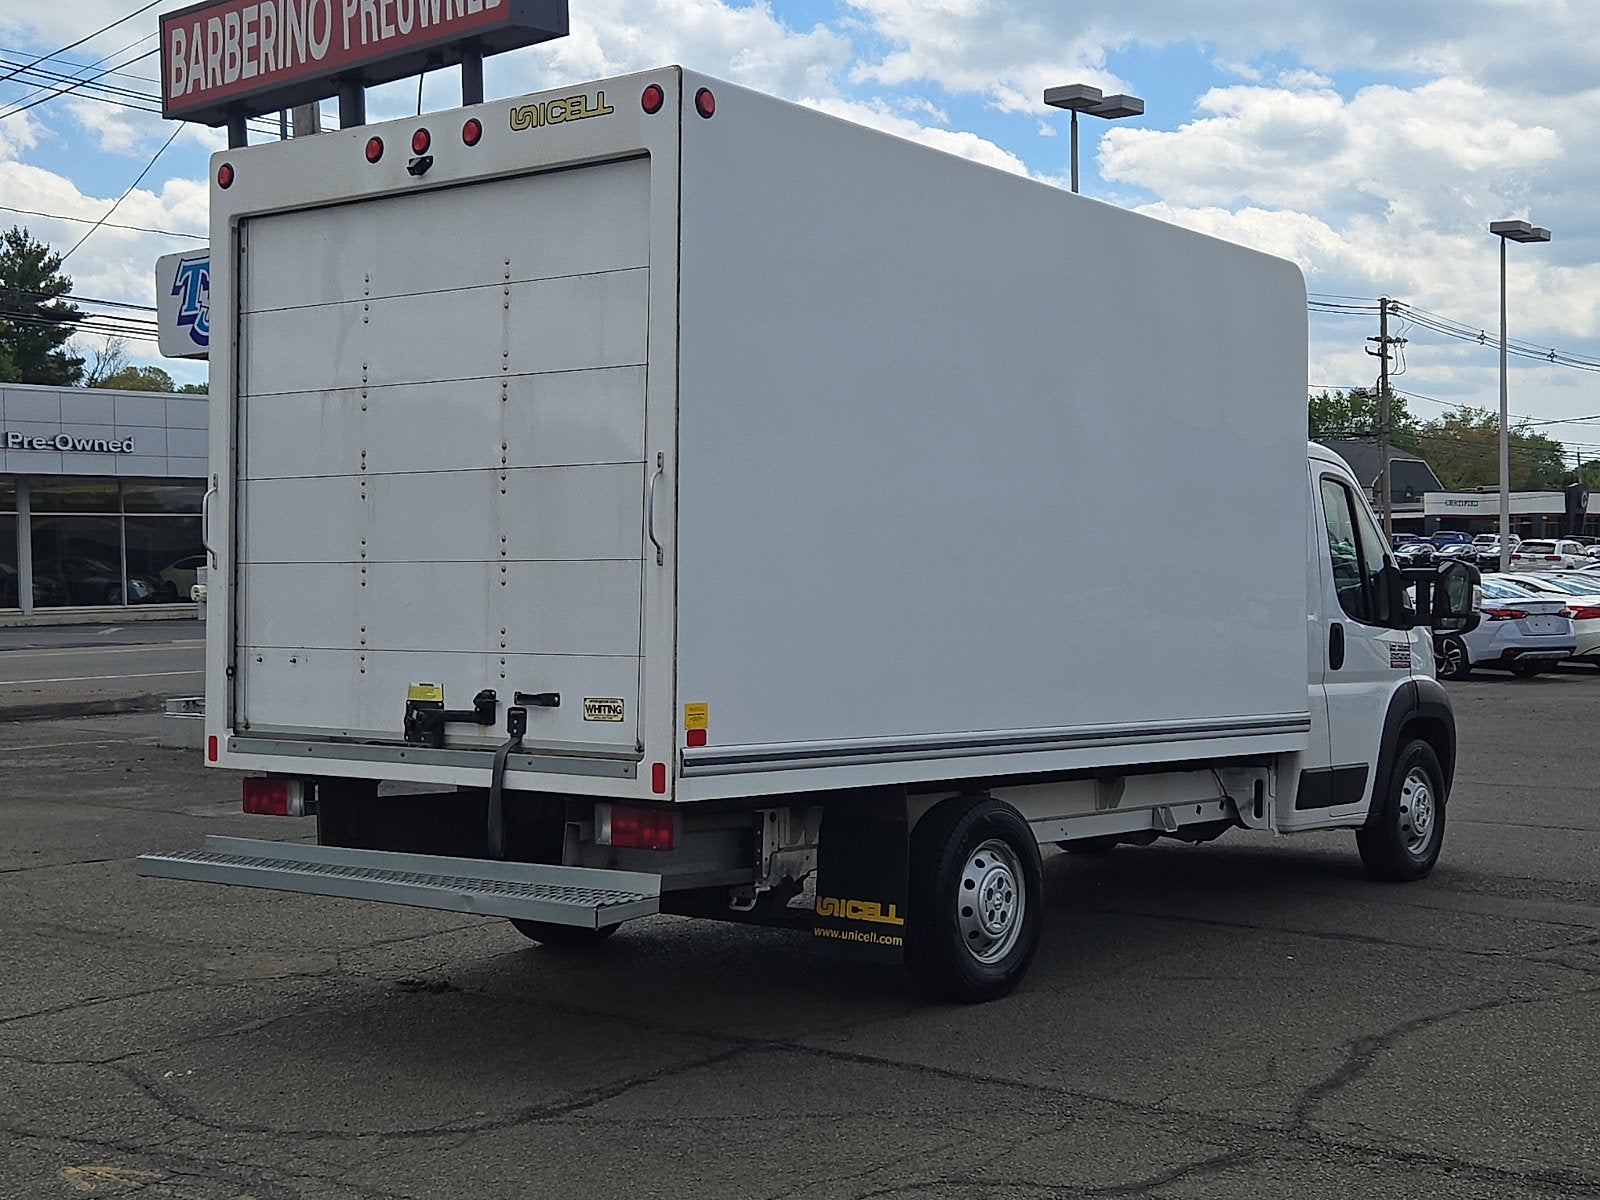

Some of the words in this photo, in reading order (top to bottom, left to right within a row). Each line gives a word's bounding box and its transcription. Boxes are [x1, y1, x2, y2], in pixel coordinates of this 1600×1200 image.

[170, 0, 332, 98] BARBERINO
[510, 91, 614, 131] UNICELL
[6, 431, 135, 453] Pre-Owned
[584, 704, 622, 714] WHITING
[816, 896, 904, 926] UNICELL
[814, 927, 903, 947] www.unicell.com
